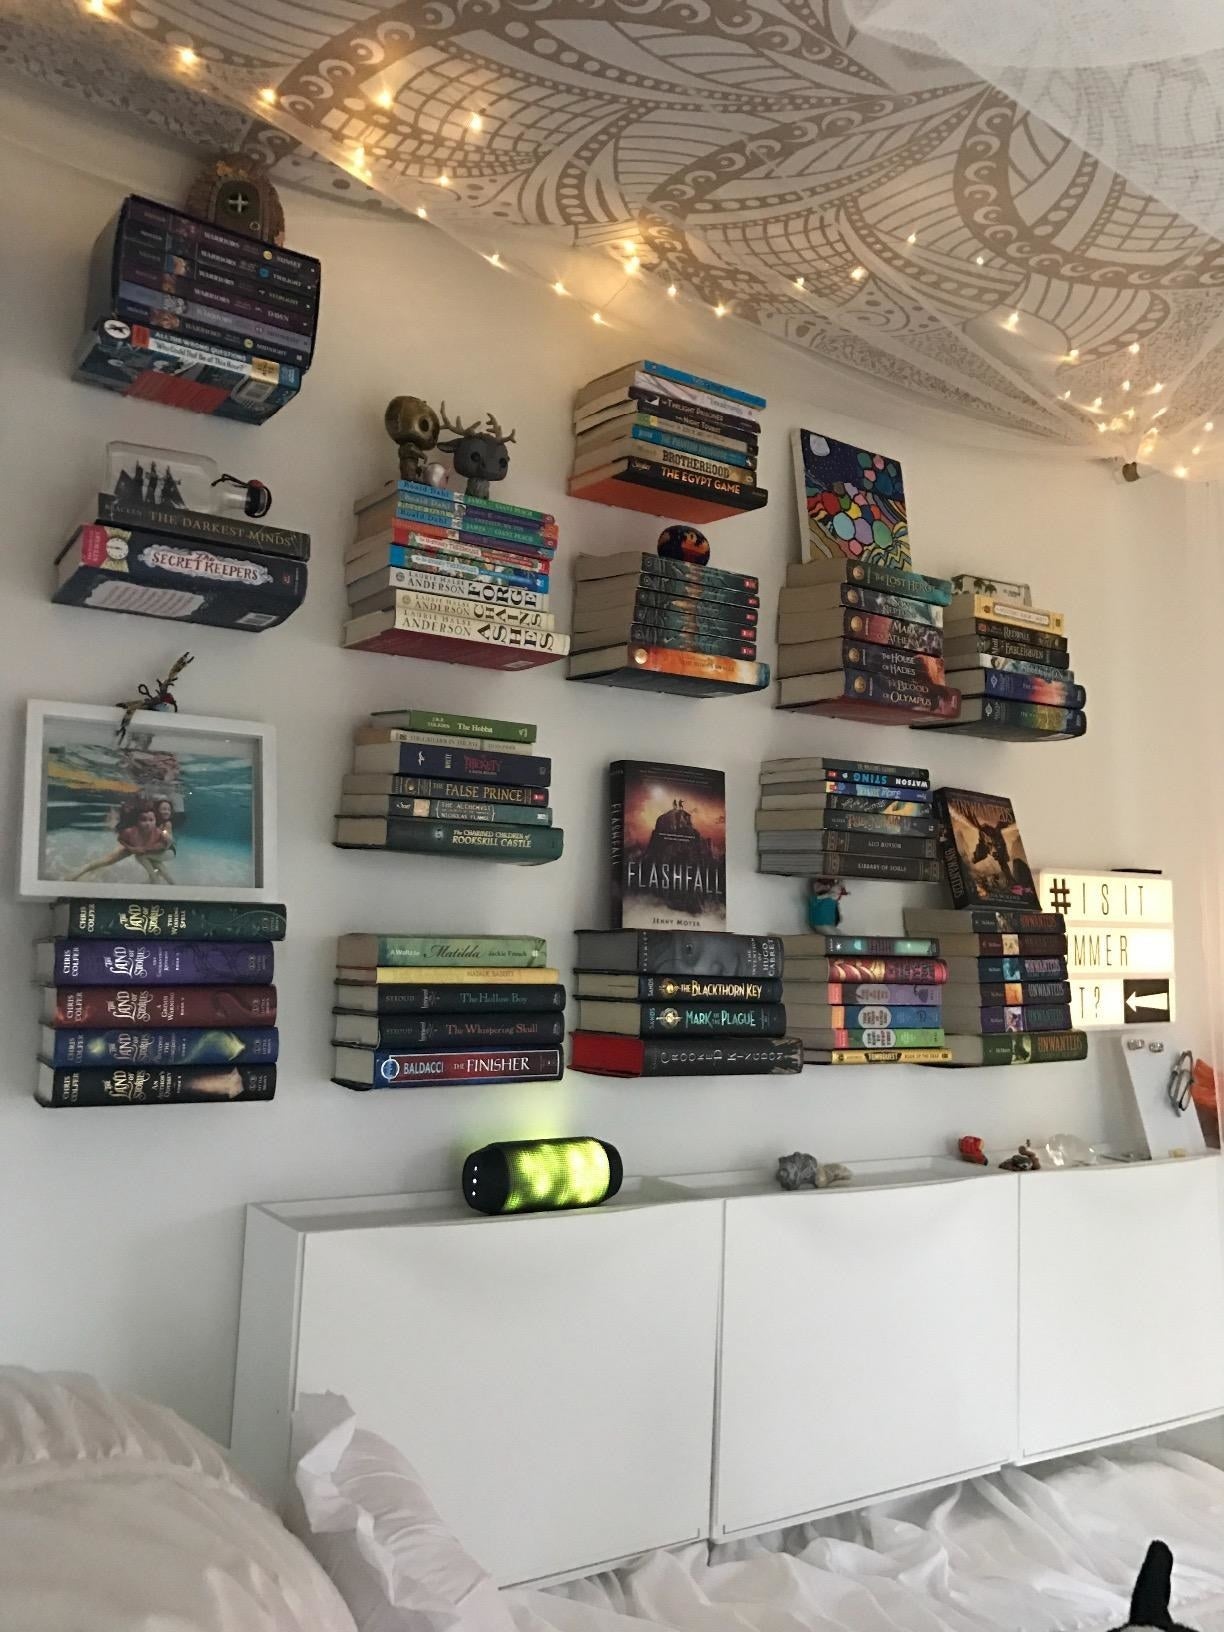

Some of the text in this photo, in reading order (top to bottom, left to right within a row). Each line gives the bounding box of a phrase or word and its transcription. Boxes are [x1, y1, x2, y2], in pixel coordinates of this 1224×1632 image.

[662, 449, 731, 479] BROTHERHOOD
[661, 466, 741, 495] THE EGYPT GAME
[149, 510, 291, 547] THE DARKEST MINDS
[151, 550, 259, 582] SECRET KEEPERS
[407, 578, 465, 596] ANDERSON
[886, 574, 906, 589] LOST
[468, 582, 538, 608] FORGE
[414, 600, 470, 618] ANDERSON
[473, 603, 542, 628] CHAINS
[402, 616, 472, 637] ANDERSON
[477, 623, 554, 651] ASHES
[890, 664, 916, 676] HADES
[891, 652, 916, 665] HOUSE
[890, 691, 932, 707] OLYMPUS
[457, 722, 493, 733] The Hobbit
[433, 782, 523, 803] THE FALSE PRINCE
[853, 772, 928, 788] WATSON STING
[452, 836, 532, 848] ROOKSKILL CASTLE
[627, 861, 723, 895] FLASHFALL
[87, 903, 95, 933] COLFER
[124, 904, 147, 936] LAND
[149, 904, 164, 936] STORIES
[652, 918, 701, 928] JENNY MOYER
[63, 950, 71, 974] CHRIS
[72, 947, 80, 977] COLFER
[110, 946, 133, 979] LAND
[134, 947, 151, 979] STORIES
[423, 944, 482, 959] Matilda
[768, 939, 776, 977] CABRET
[1065, 933, 1128, 967] MMER
[460, 992, 528, 1005] The Hollow Boy
[680, 980, 763, 999] THE BLACKTHORN KEY
[75, 992, 83, 1022] COLFER
[113, 990, 136, 1022] LAND
[137, 990, 154, 1022] STORIES
[446, 1023, 538, 1036] The Whispering Skull
[685, 1010, 756, 1029] MARK PLAGUE
[75, 1035, 83, 1064] COLFER
[114, 1033, 136, 1062] LAND
[138, 1033, 154, 1063] STORIES
[660, 1049, 784, 1064] CROOKED KINGDOM
[403, 1061, 444, 1075] BALDACCI
[453, 1056, 530, 1073] THE FINISHER
[110, 1070, 133, 1100] LAND
[134, 1070, 151, 1101] STORIES
